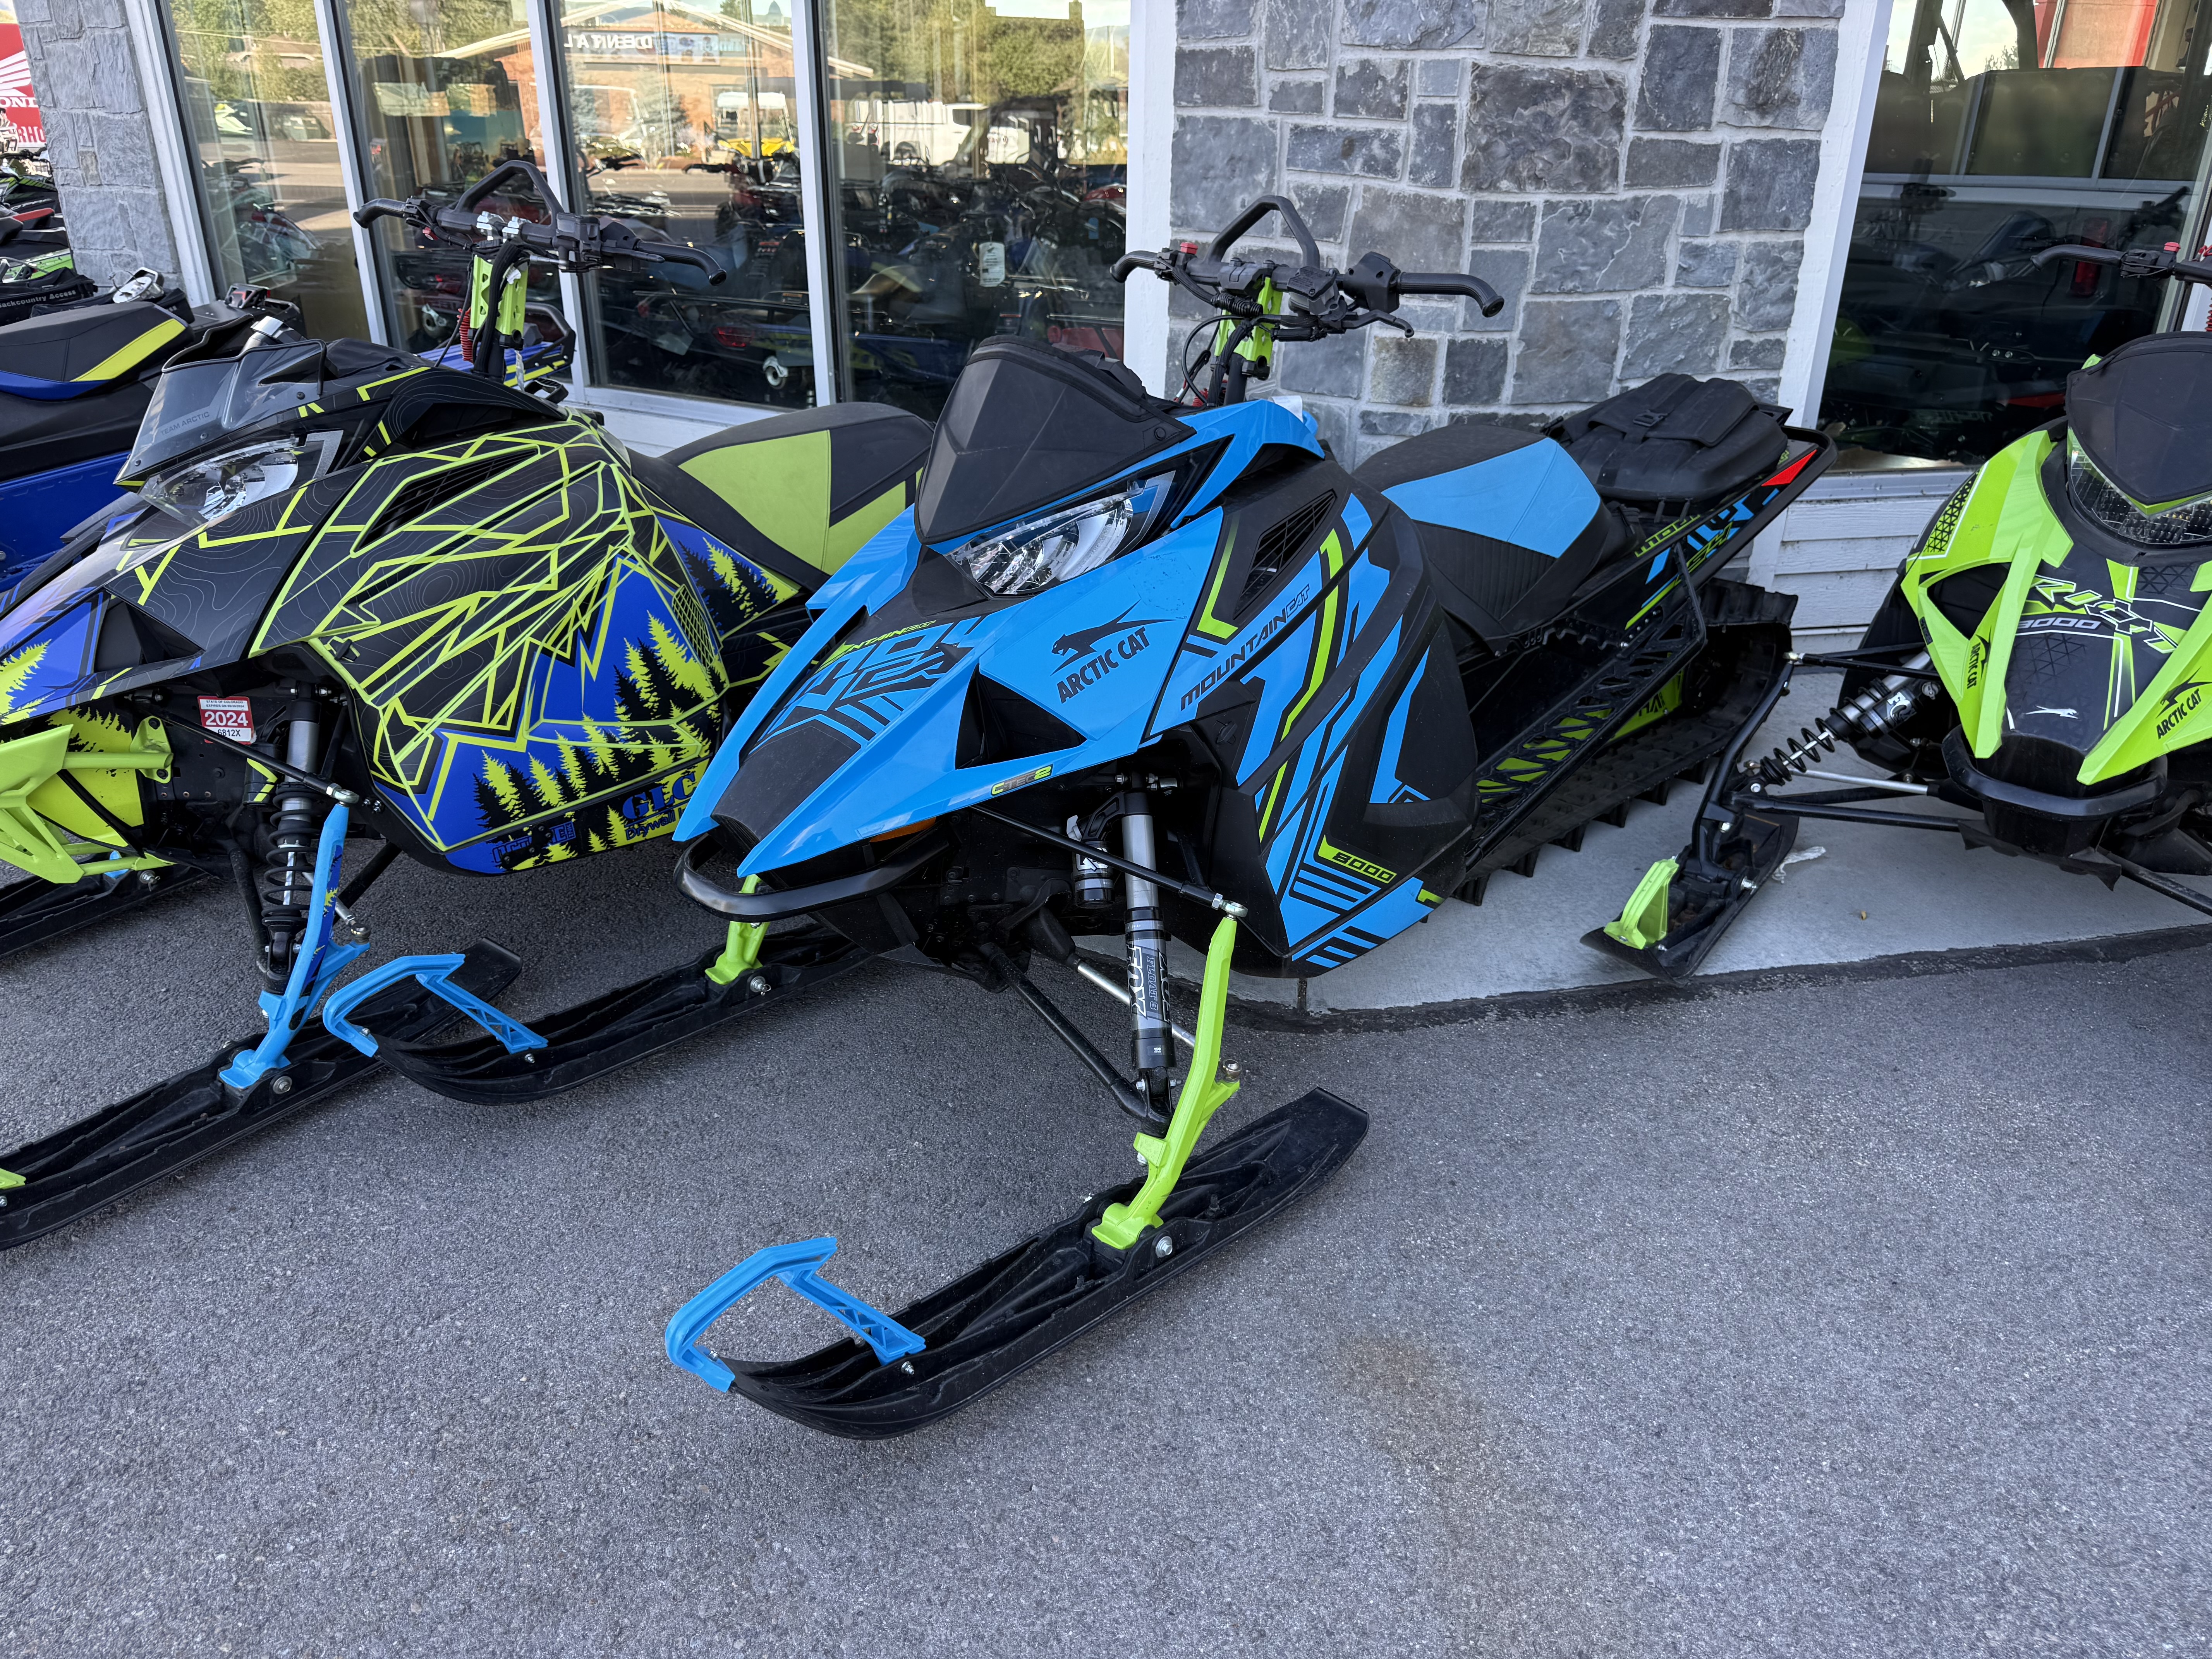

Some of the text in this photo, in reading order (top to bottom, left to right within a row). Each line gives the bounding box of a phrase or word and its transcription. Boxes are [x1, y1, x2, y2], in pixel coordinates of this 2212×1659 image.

[49, 289, 76, 300] Access
[161, 411, 210, 435] TEAM ARCTIC
[1057, 626, 1150, 704] ARCTIC CAT
[205, 711, 248, 726] 2024
[2156, 688, 2202, 740] ARCTIC CAT
[622, 772, 696, 820] GLC
[625, 809, 676, 841] Drywall
[1332, 852, 1394, 882] 8000
[1147, 956, 1158, 1011] FLOAT 3
